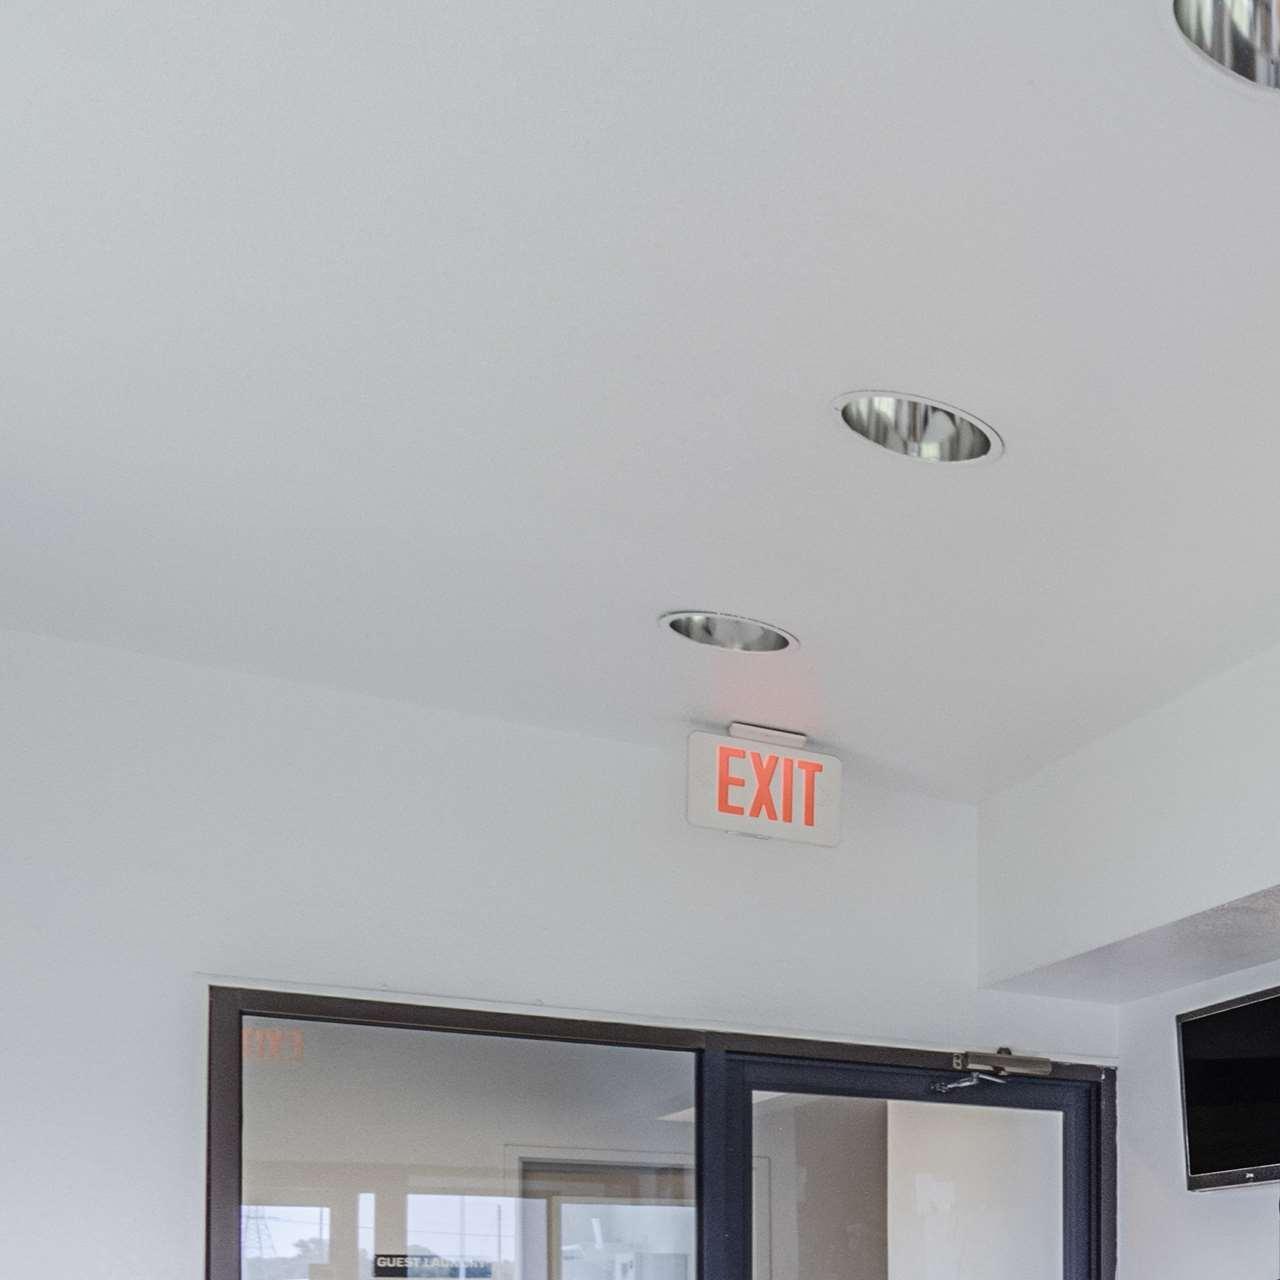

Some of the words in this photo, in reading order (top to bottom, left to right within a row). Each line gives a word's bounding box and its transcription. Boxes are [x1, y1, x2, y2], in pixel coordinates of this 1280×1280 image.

[716, 745, 824, 827] EXIT
[376, 1257, 420, 1268] GUEST
[422, 1257, 488, 1268] LAURY
